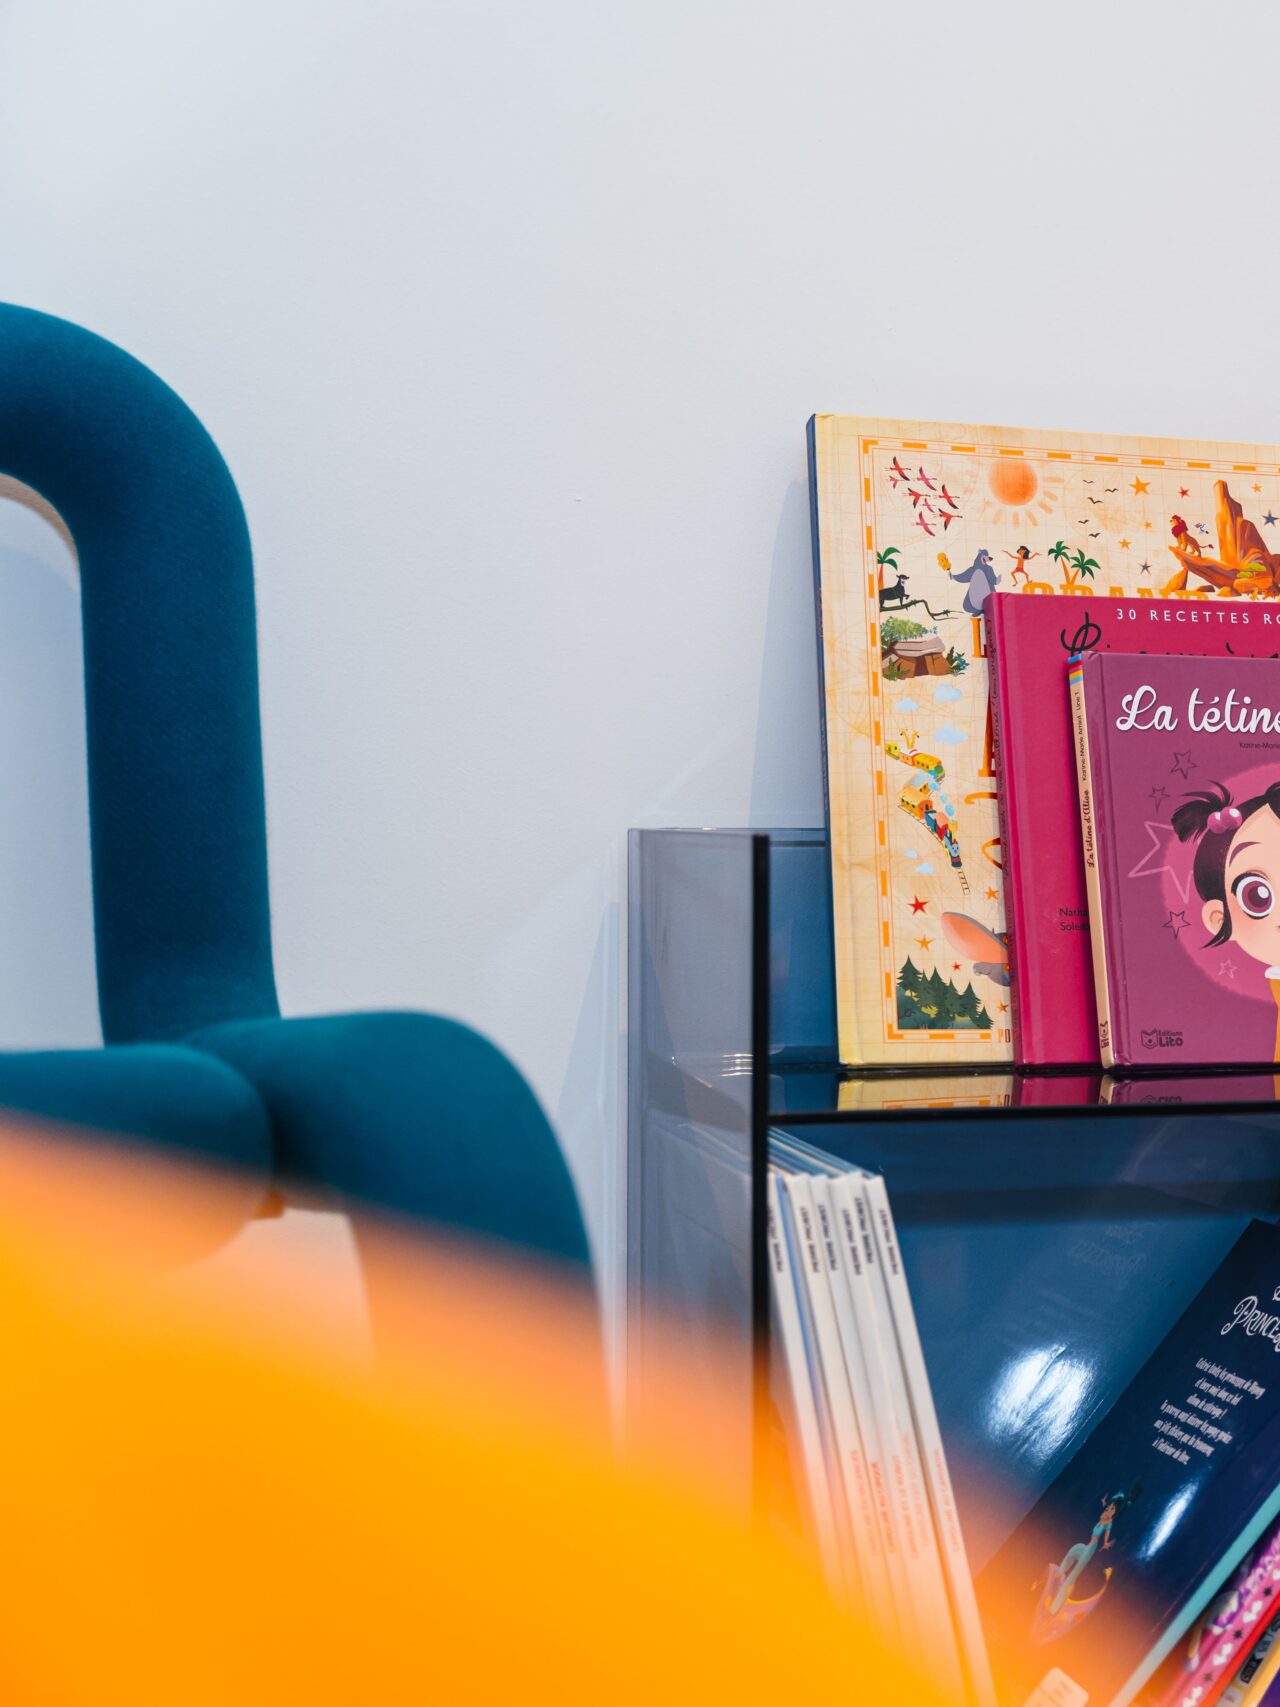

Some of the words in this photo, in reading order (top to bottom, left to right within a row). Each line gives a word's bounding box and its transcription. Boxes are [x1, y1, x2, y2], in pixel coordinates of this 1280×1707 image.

[1116, 608, 1137, 620] 30
[1150, 610, 1250, 624] RECETTES
[1116, 685, 1178, 731] La
[1059, 907, 1088, 917] Natha
[1159, 1036, 1184, 1048] Lito
